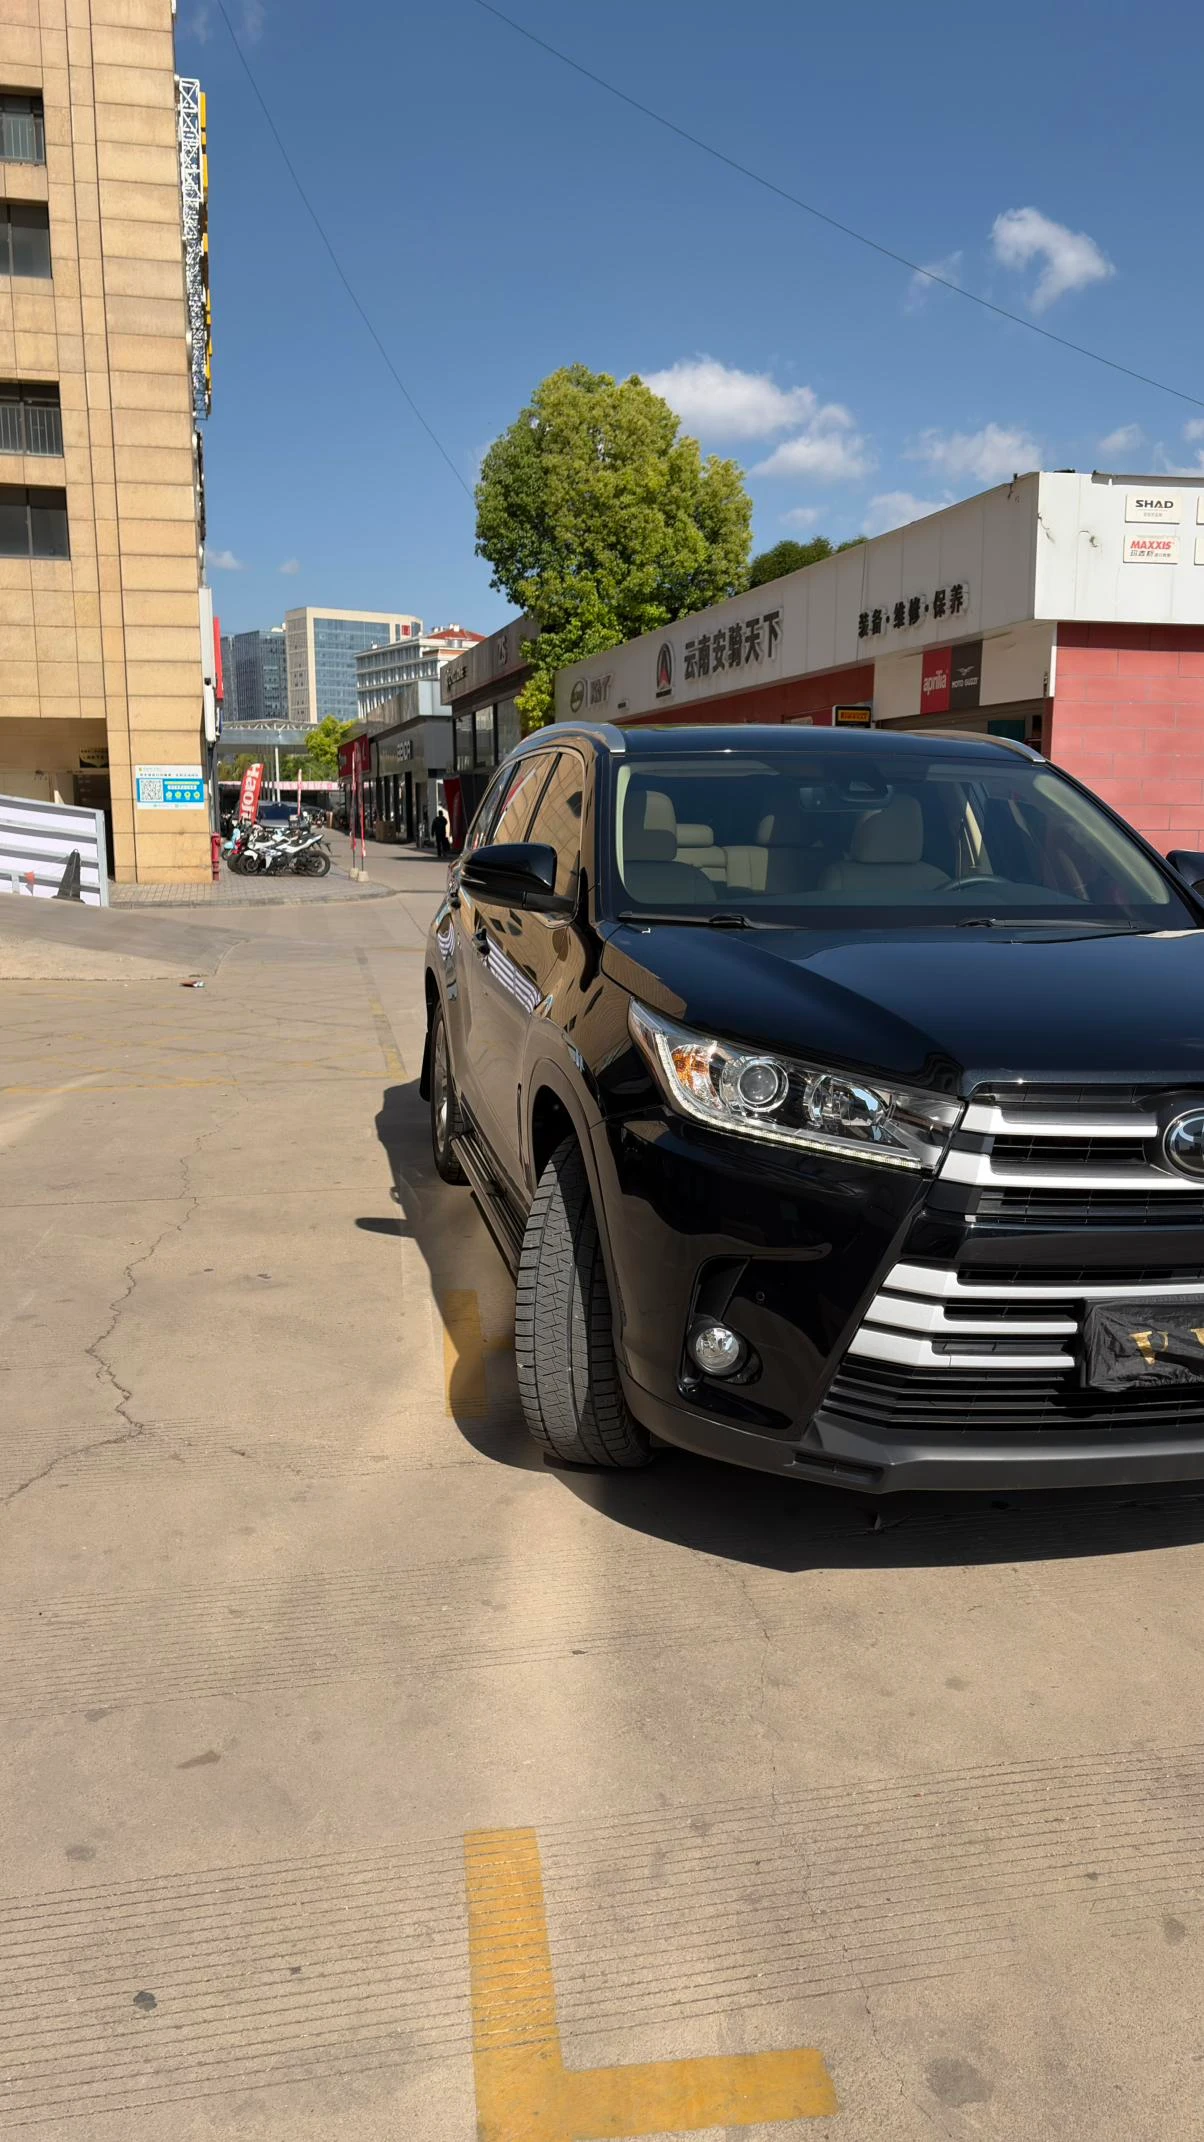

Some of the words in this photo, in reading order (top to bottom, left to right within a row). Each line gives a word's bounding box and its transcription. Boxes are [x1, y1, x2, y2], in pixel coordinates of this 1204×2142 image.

[1135, 499, 1174, 509] SHAD
[1130, 540, 1172, 550] MAXXIS
[684, 610, 780, 680] 云南安骑天下
[923, 669, 947, 696] aprilia
